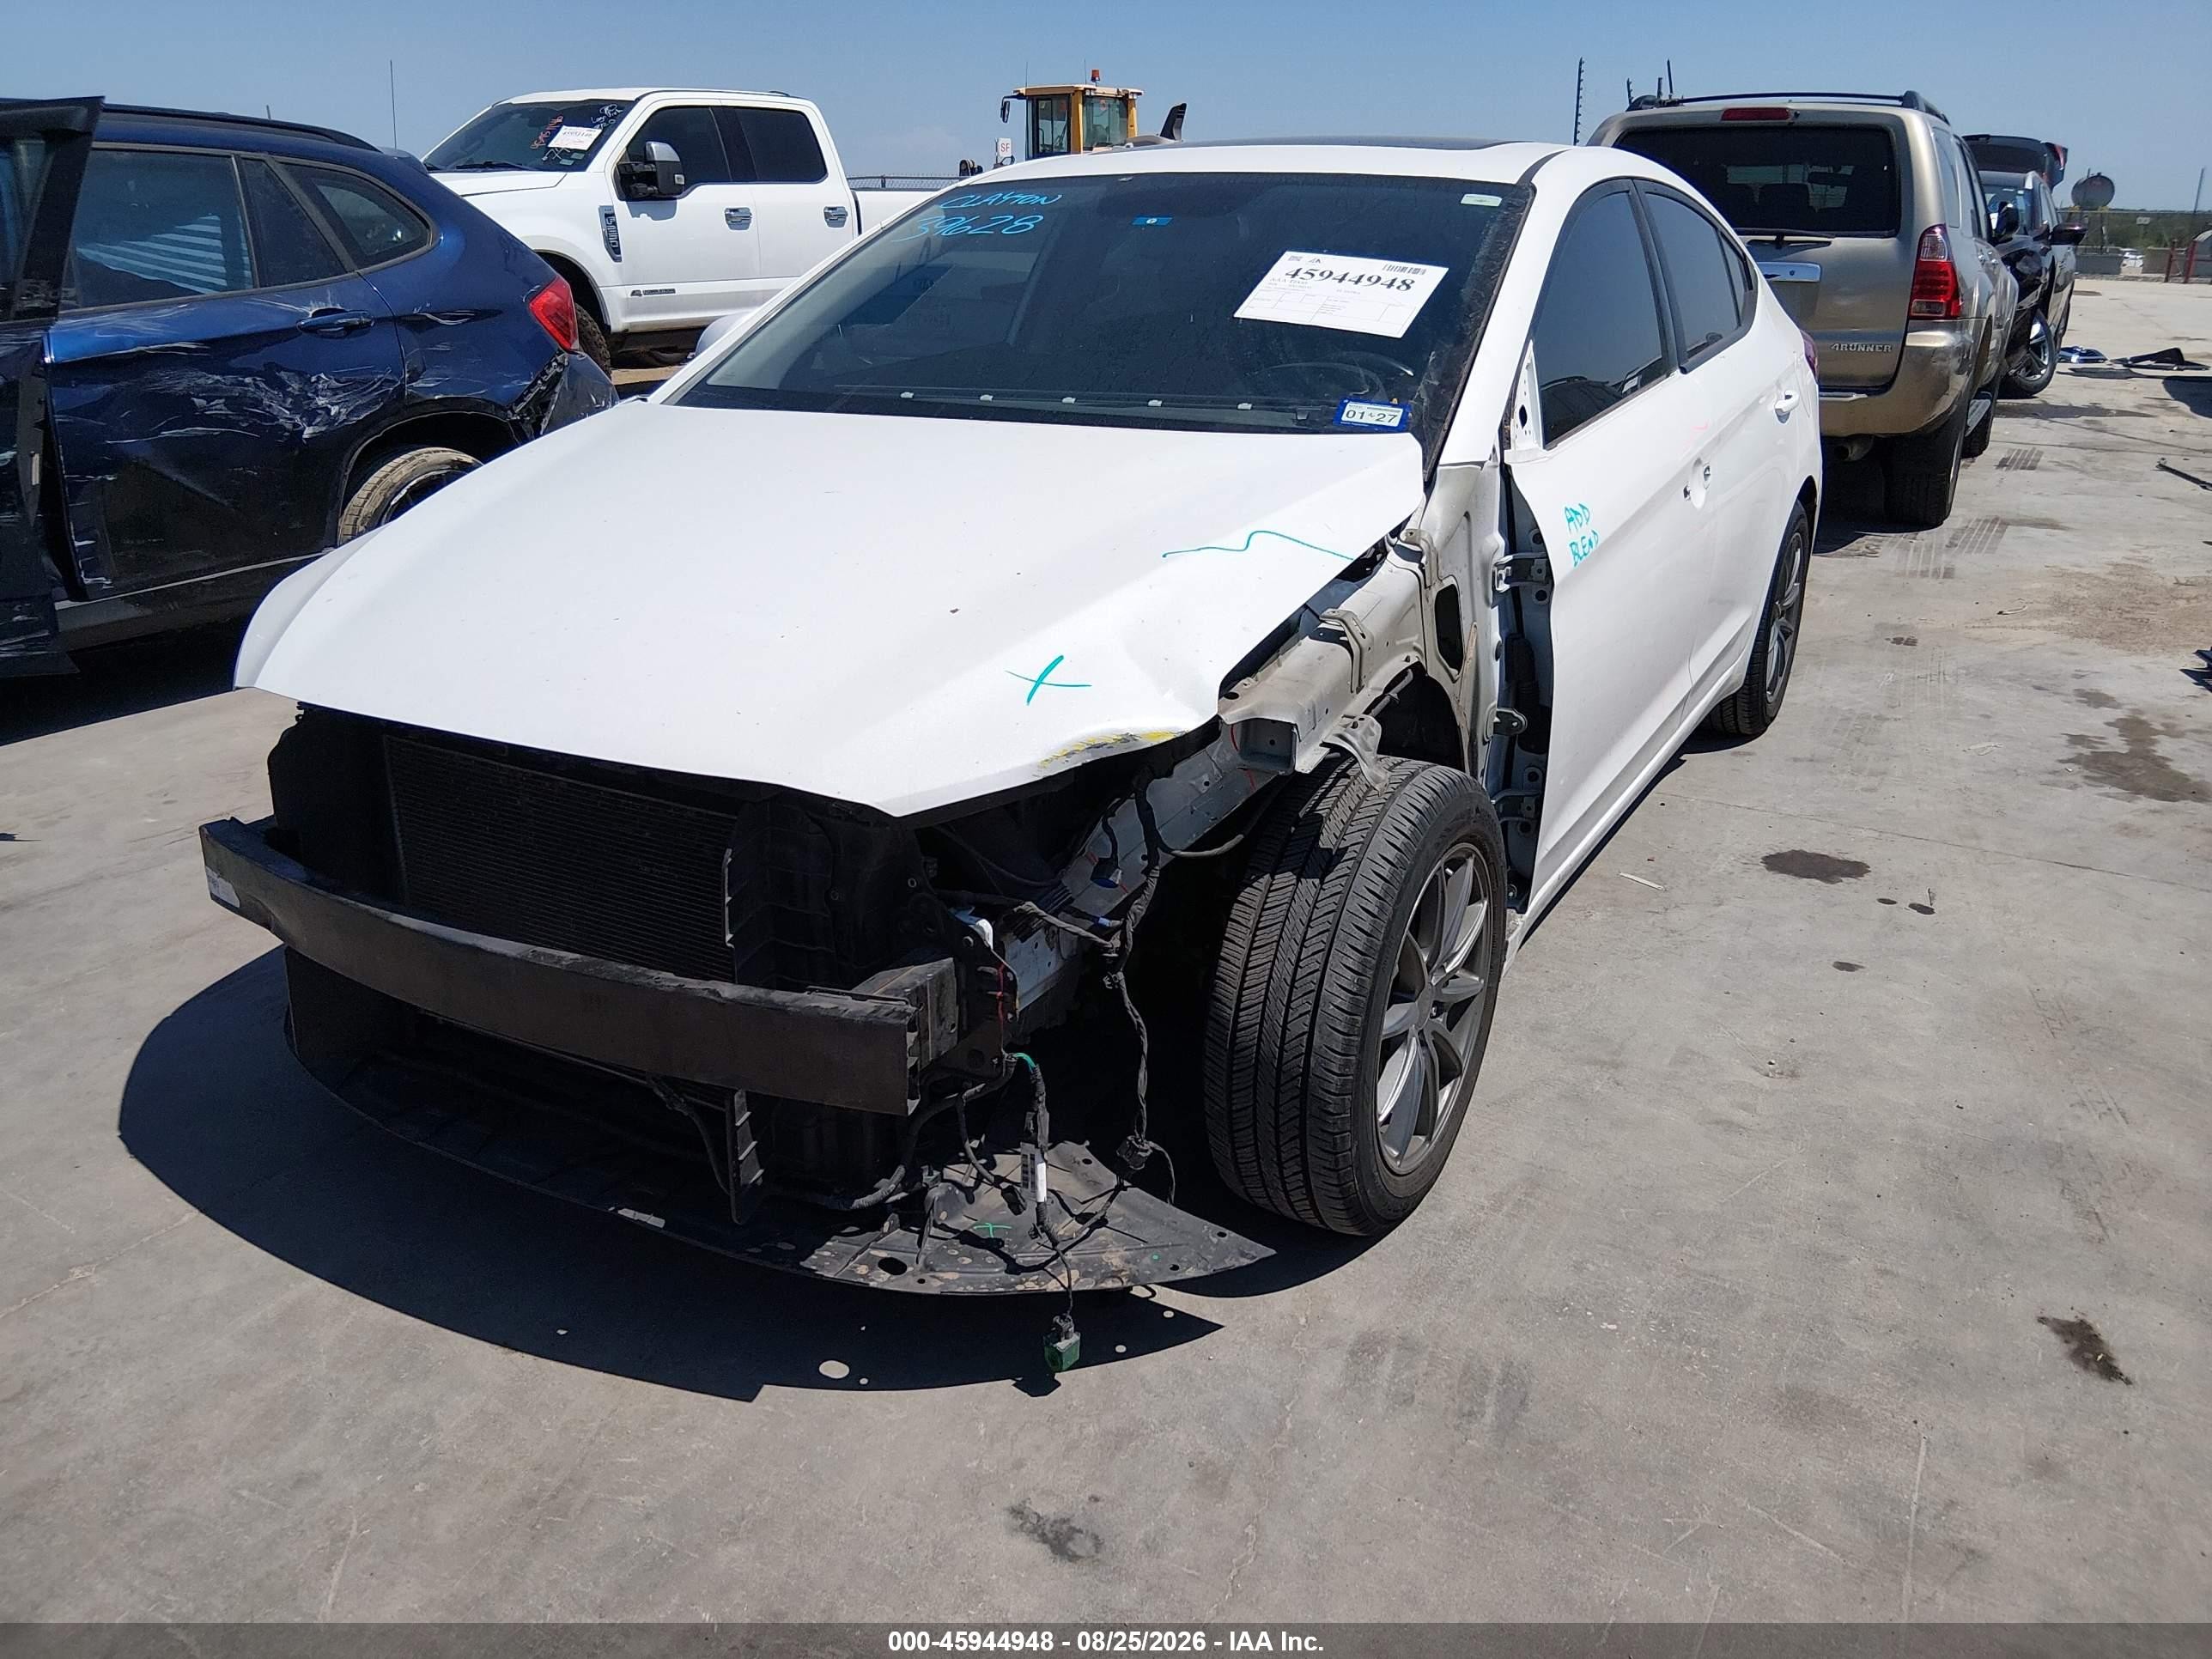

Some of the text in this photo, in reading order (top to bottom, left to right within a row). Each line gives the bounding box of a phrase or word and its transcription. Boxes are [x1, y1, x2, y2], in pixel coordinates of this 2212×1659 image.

[1000, 143, 1011, 152] SF
[1285, 267, 1415, 291] 45944948
[1831, 343, 1893, 352] 4RUNNER
[1565, 503, 1590, 533] ADD
